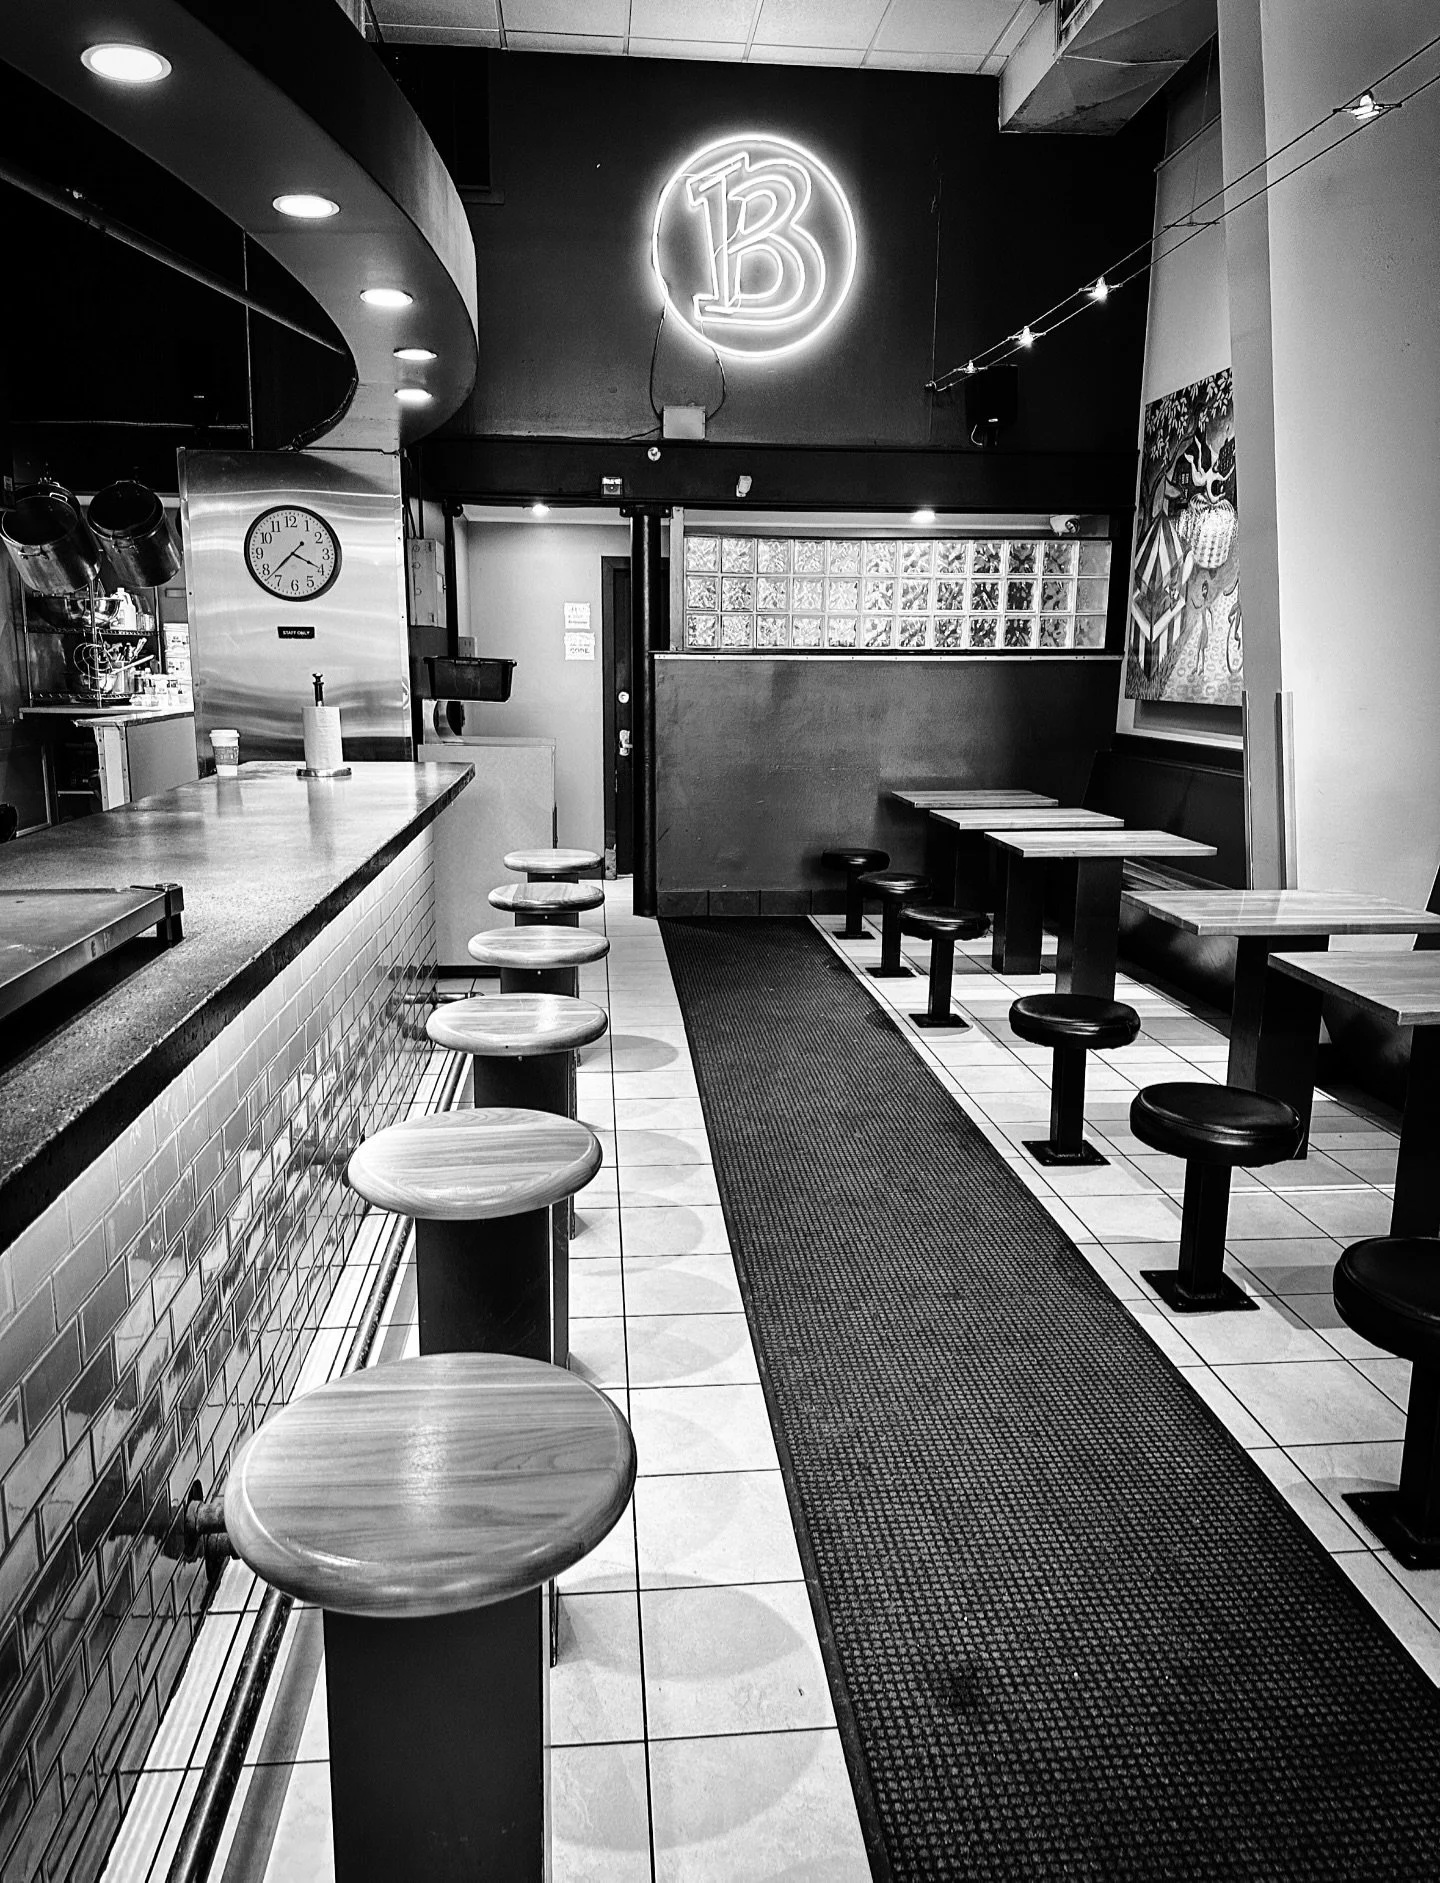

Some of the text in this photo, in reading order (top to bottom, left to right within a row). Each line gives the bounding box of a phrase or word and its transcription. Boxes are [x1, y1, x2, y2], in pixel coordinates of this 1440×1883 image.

[271, 521, 280, 532] 11
[284, 516, 298, 528] 12
[305, 520, 310, 532] 1
[261, 532, 272, 544] 10
[315, 532, 323, 544] 2
[256, 547, 264, 559] 9
[322, 548, 330, 560] 3
[262, 564, 270, 575] 8
[317, 564, 324, 576] 4
[274, 575, 282, 587] 7
[291, 580, 299, 591] 6
[306, 576, 314, 587] 5
